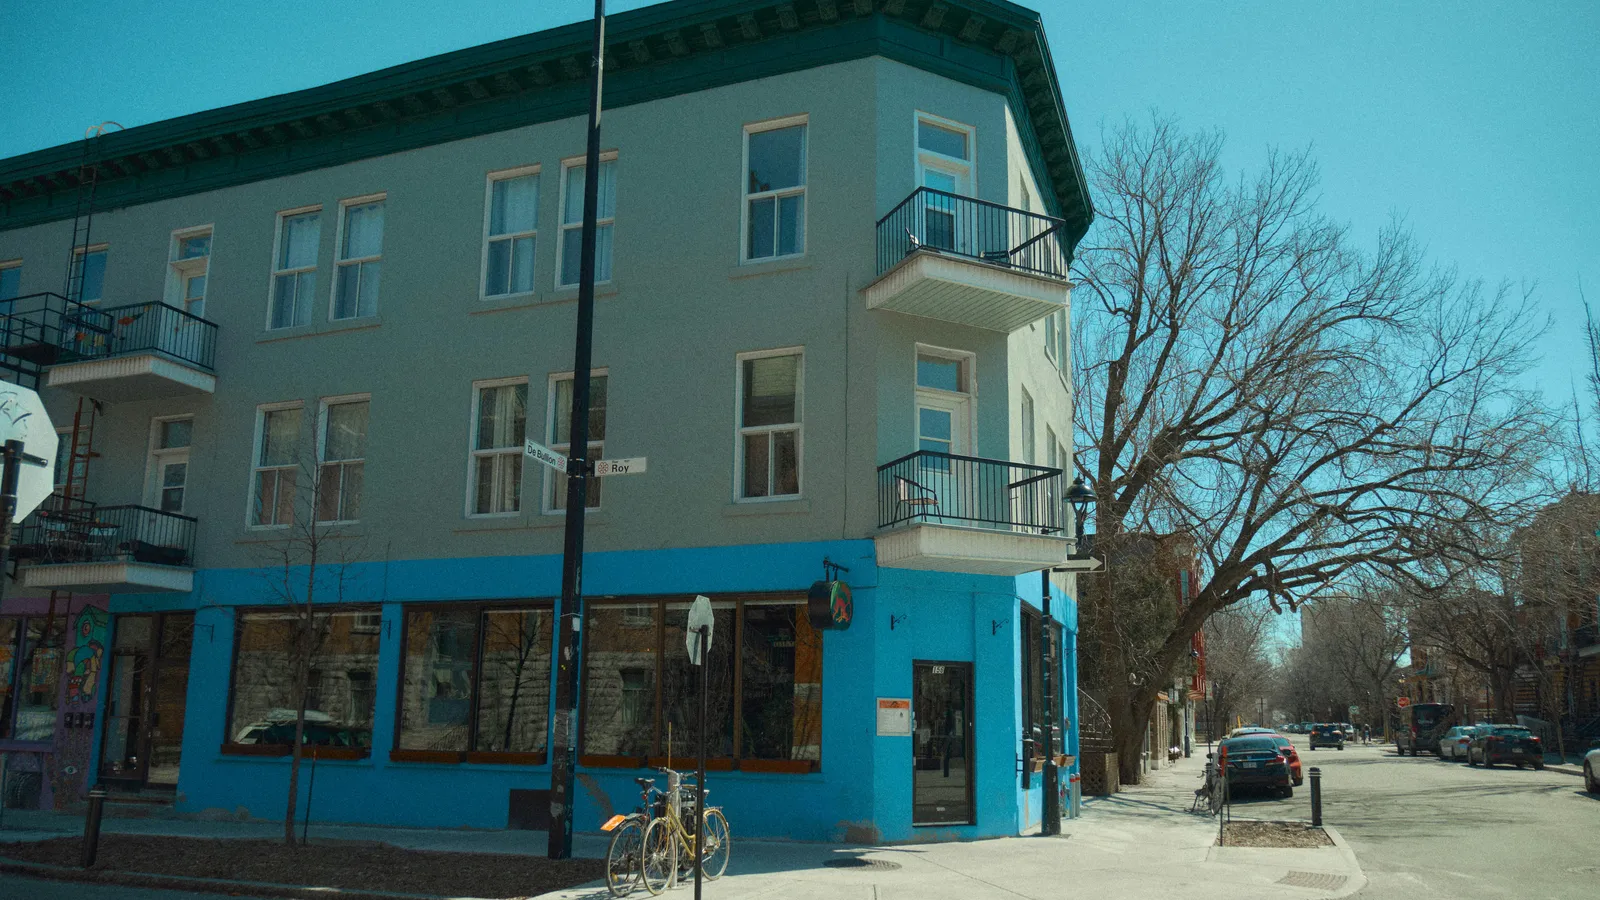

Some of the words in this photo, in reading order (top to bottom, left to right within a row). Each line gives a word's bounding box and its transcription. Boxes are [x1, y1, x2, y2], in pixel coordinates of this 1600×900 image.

[527, 445, 536, 456] De
[537, 449, 556, 465] Buon
[611, 464, 629, 473] Roy
